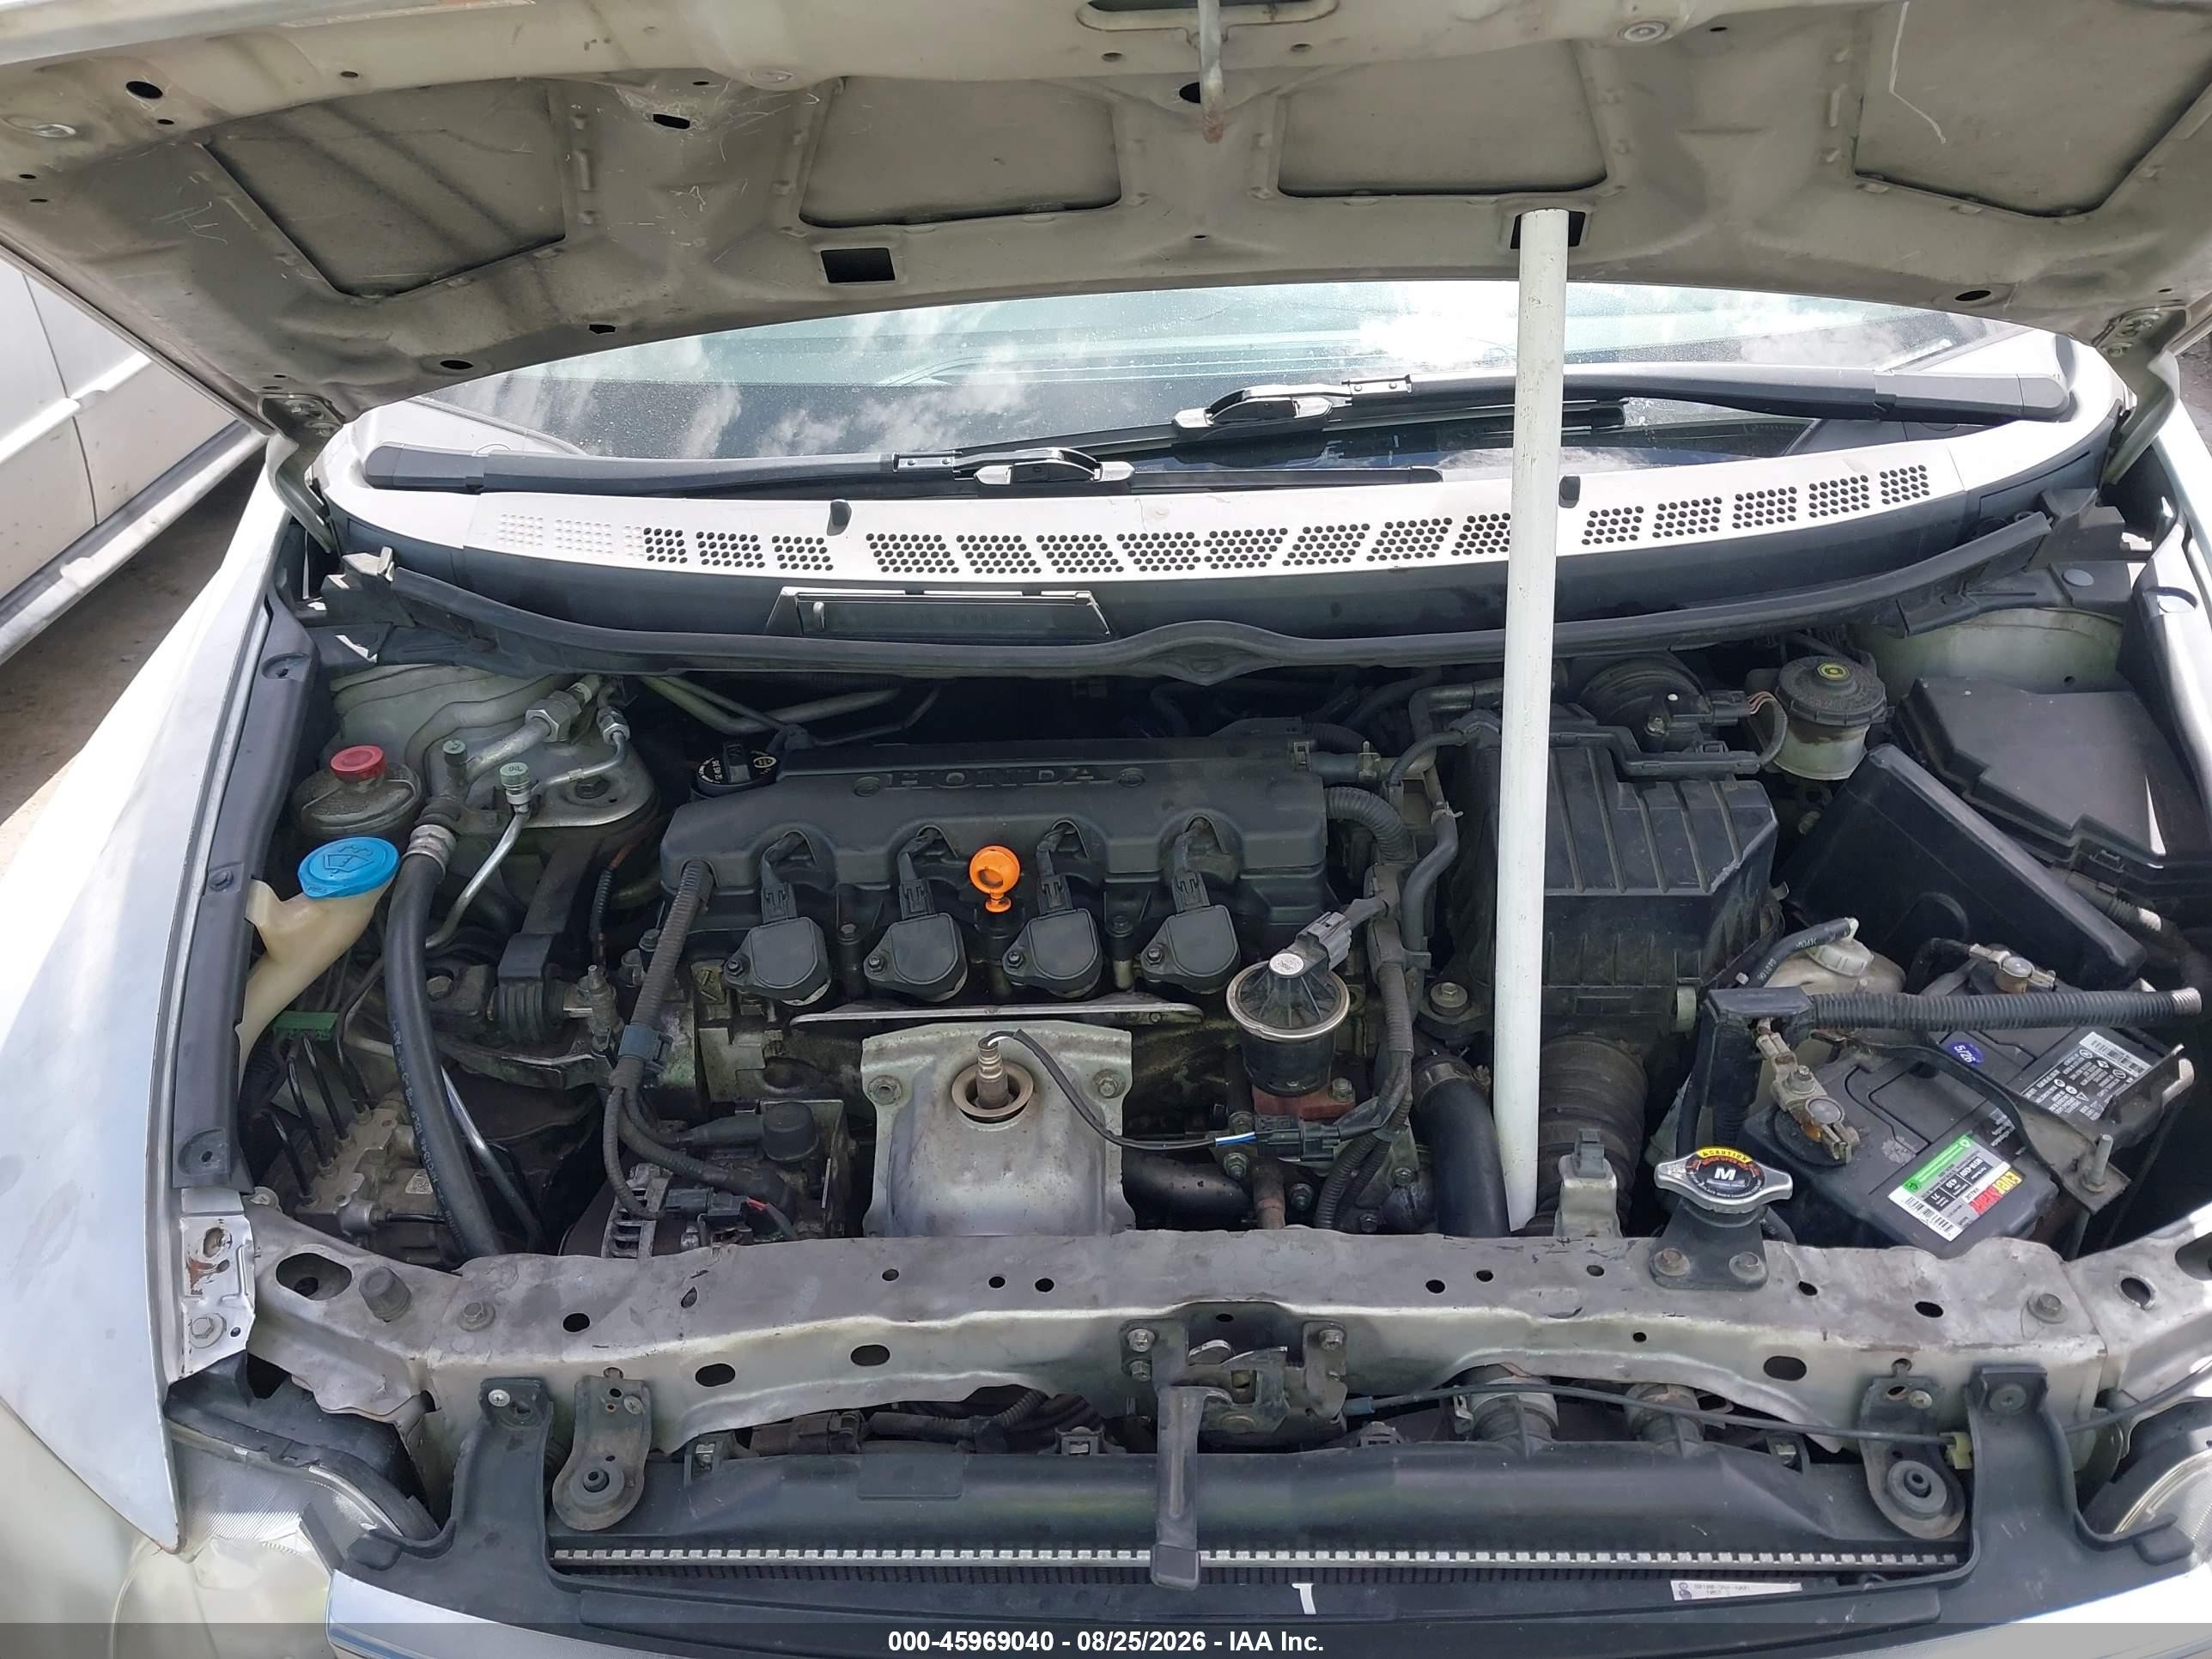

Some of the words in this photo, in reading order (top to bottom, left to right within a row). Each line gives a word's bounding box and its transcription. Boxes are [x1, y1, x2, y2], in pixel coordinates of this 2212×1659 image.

[884, 766, 1111, 790] HONDA
[1954, 1045, 1976, 1063] 5/26
[1709, 1151, 1749, 1162] CAUTION
[1714, 1167, 1736, 1181] M
